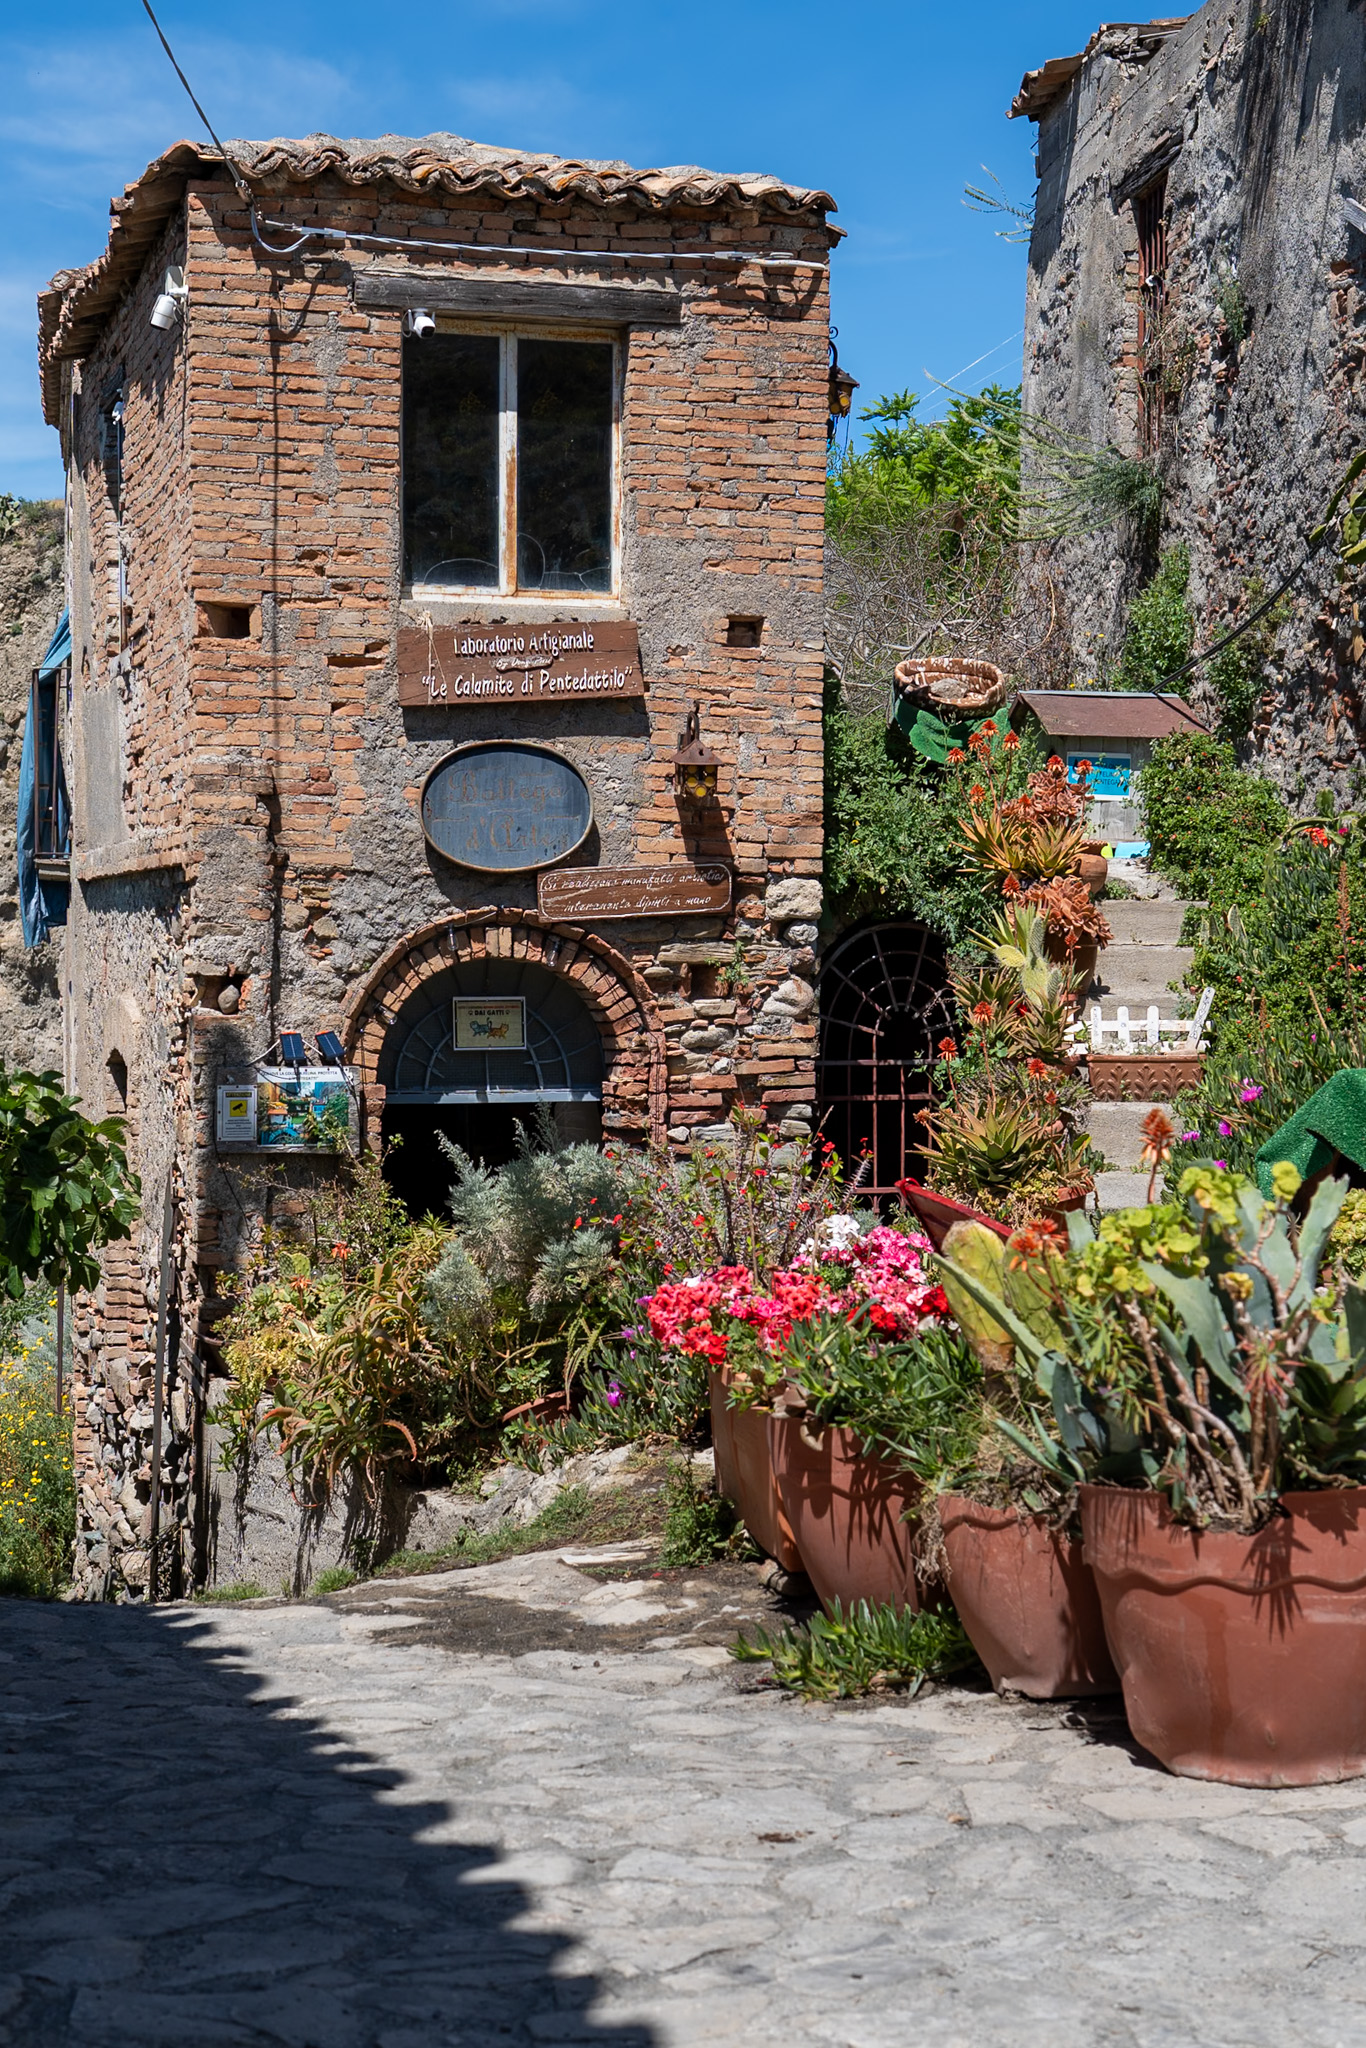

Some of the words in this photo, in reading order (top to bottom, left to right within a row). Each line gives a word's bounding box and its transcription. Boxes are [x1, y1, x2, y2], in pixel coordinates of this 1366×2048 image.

[453, 632, 525, 656] Laboratorio
[529, 628, 595, 657] Artigianale
[454, 672, 515, 697] Calamite
[521, 671, 533, 694] di
[449, 768, 564, 813] Bottega
[544, 875, 558, 890] Si
[621, 871, 676, 890] manufatti
[635, 894, 671, 913] dipinti
[685, 896, 712, 905] mano
